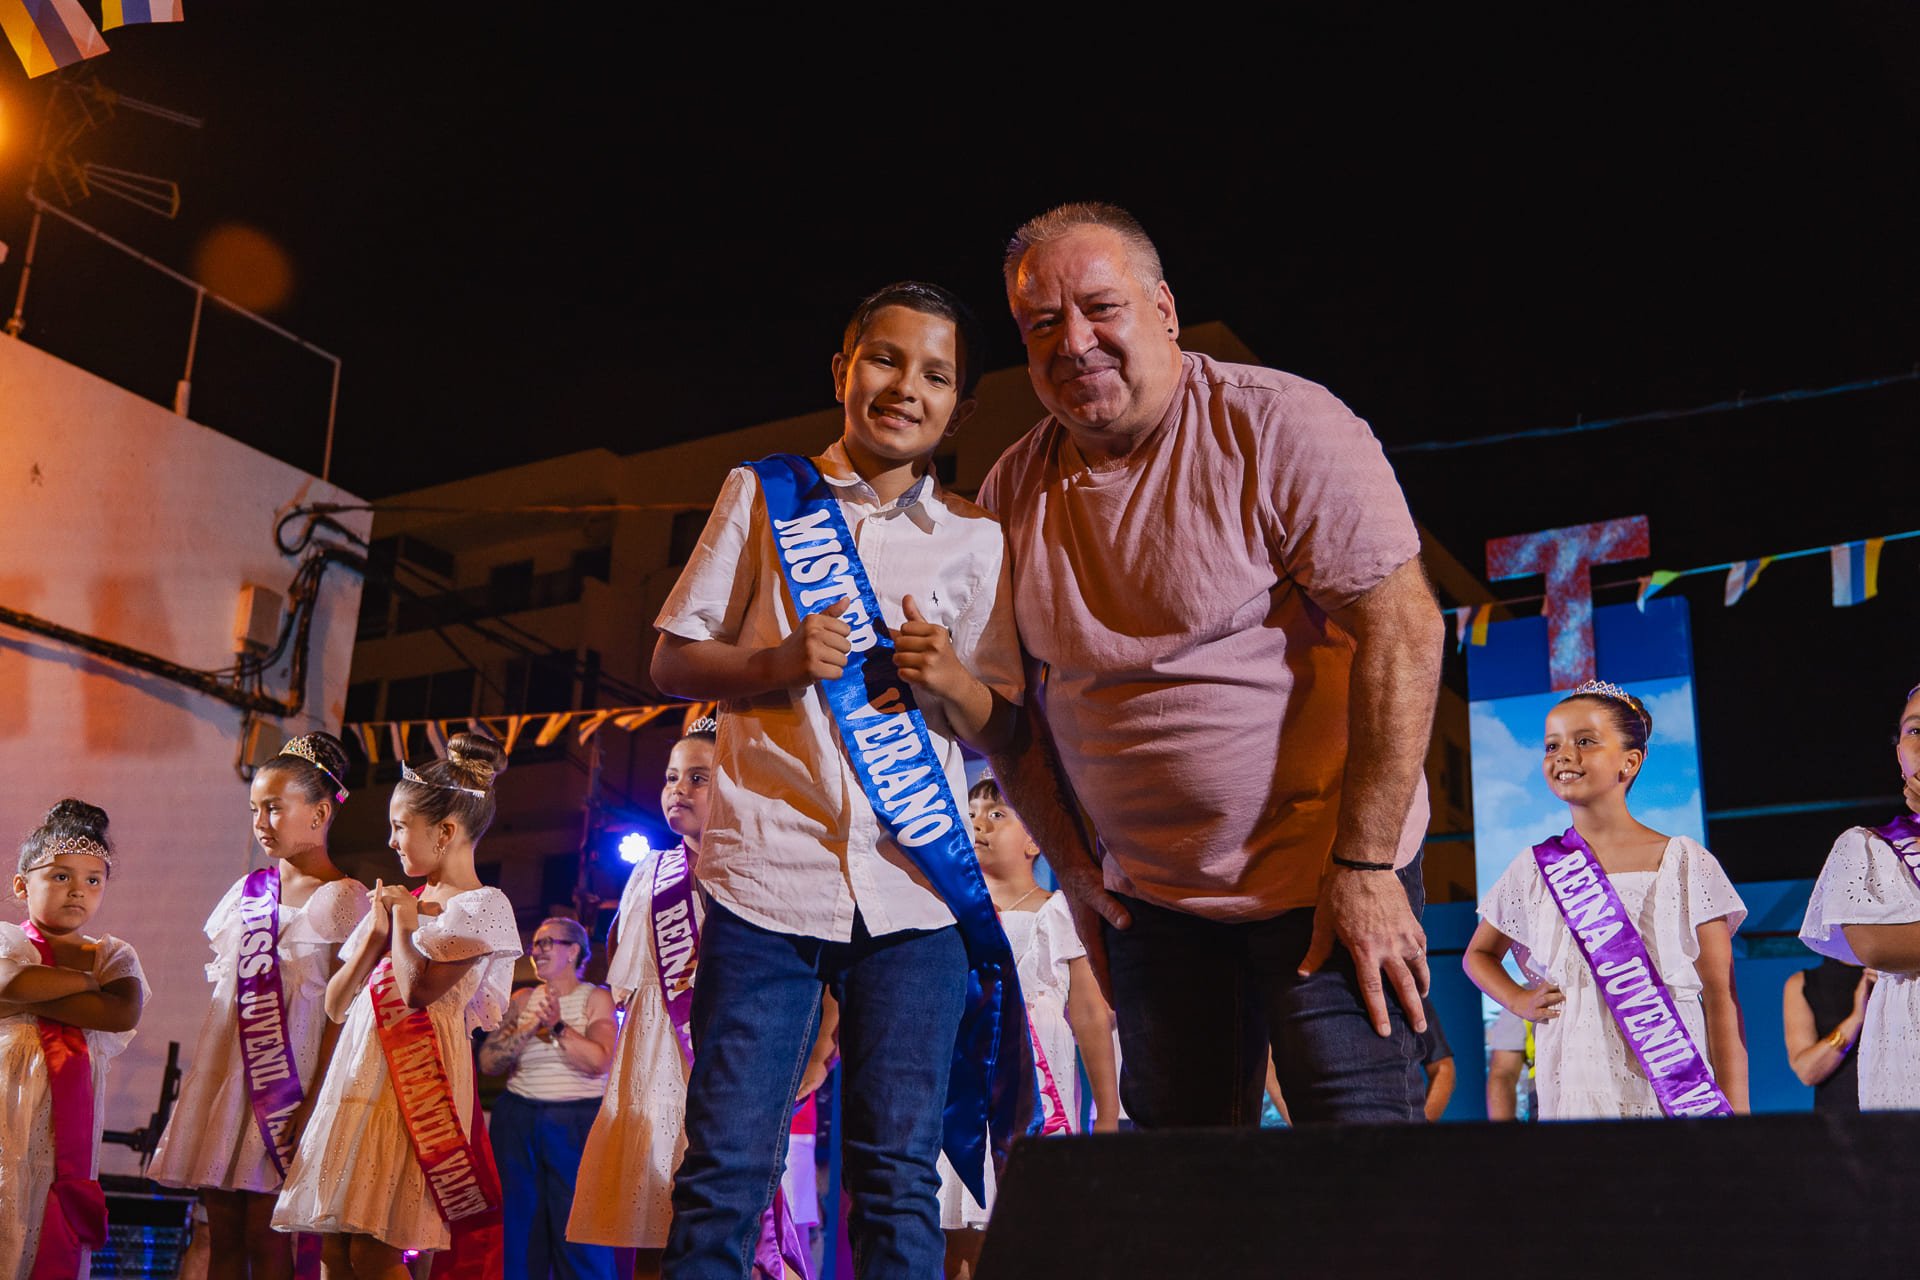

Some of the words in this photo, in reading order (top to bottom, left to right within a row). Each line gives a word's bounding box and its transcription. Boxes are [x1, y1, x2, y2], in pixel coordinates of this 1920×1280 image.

[1486, 515, 1651, 692] T
[845, 686, 954, 848] VERANO
[238, 890, 274, 979] MISS
[656, 899, 697, 1001] REINA
[1544, 849, 1624, 954] REINA
[1597, 956, 1695, 1078] JUVENIL
[240, 991, 290, 1091] JUVENIL
[391, 1036, 458, 1155] INFANTIL
